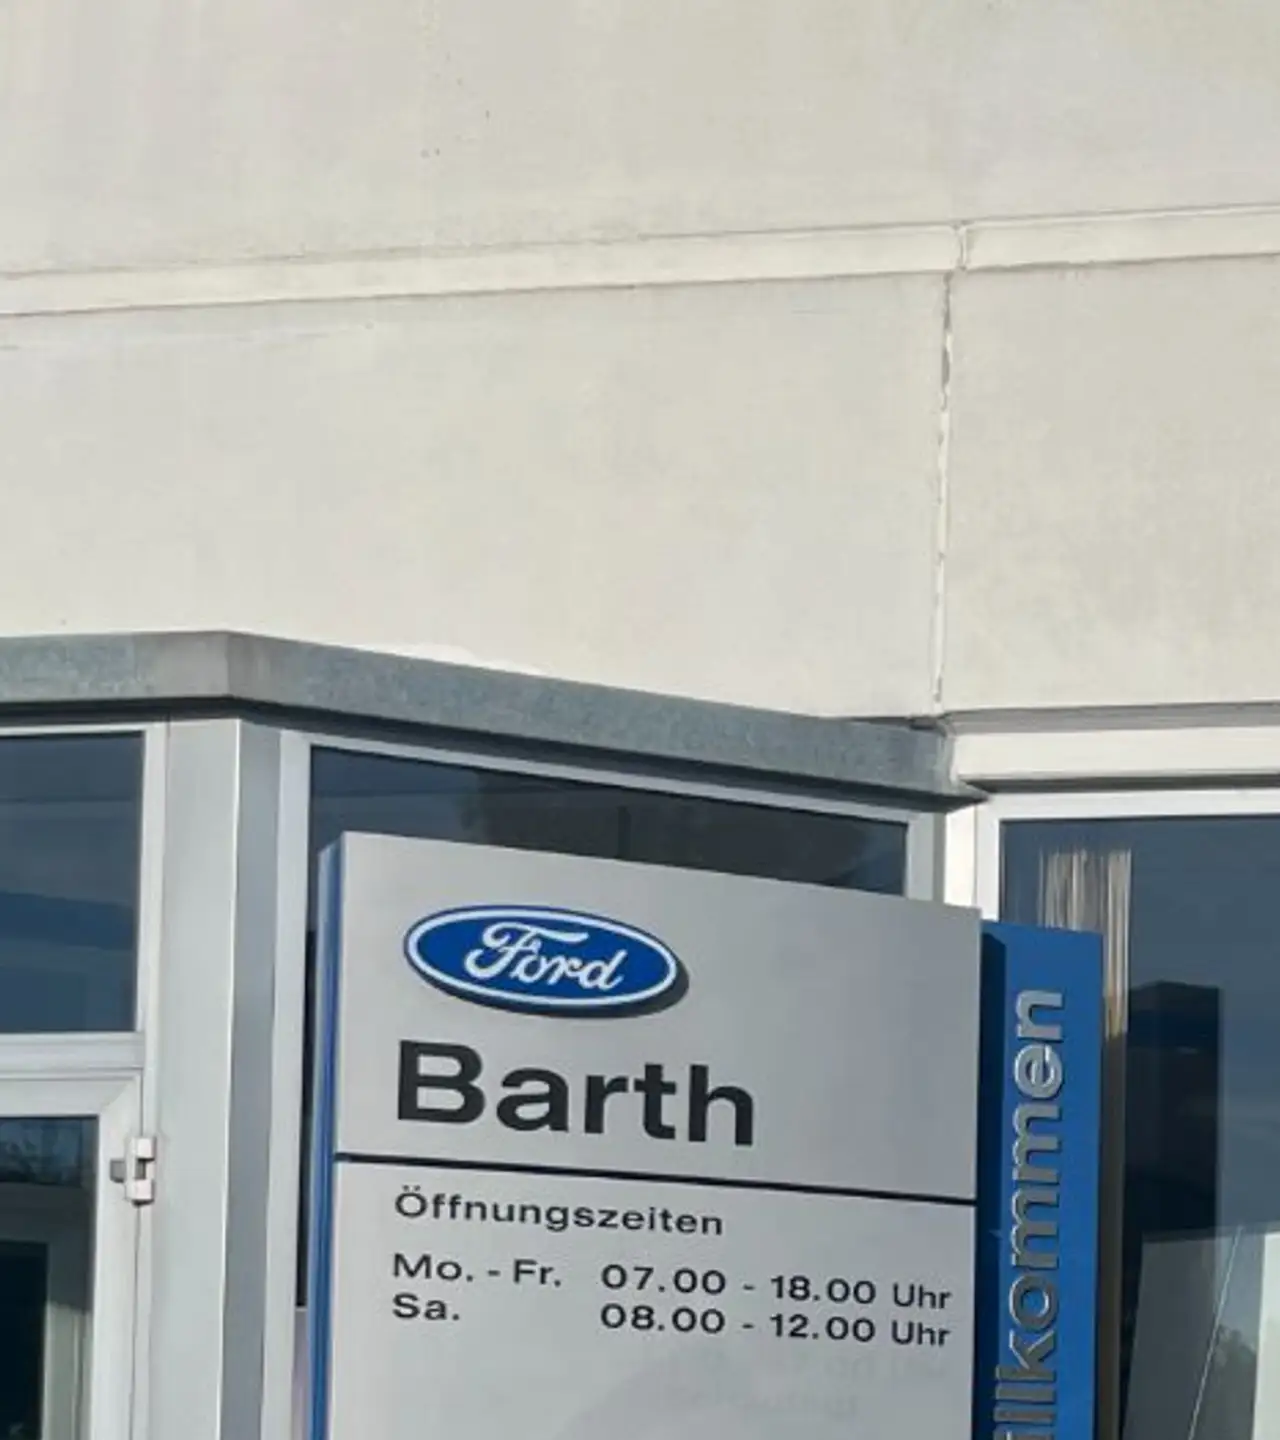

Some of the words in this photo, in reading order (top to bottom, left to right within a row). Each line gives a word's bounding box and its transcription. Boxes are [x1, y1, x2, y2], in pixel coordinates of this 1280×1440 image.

[463, 920, 623, 992] Ford
[396, 1039, 755, 1147] Barth
[394, 1184, 724, 1237] Öffnungszeiten
[392, 1252, 474, 1283] Mo.
[512, 1258, 562, 1288] Fr.
[600, 1262, 727, 1296] 07.00
[769, 1274, 878, 1306] 18.00
[891, 1281, 953, 1311] Uhr
[392, 1292, 460, 1322] Sa.
[599, 1302, 727, 1335] 08.00
[768, 1312, 877, 1344] 12.00
[890, 1318, 952, 1348] Uhr
